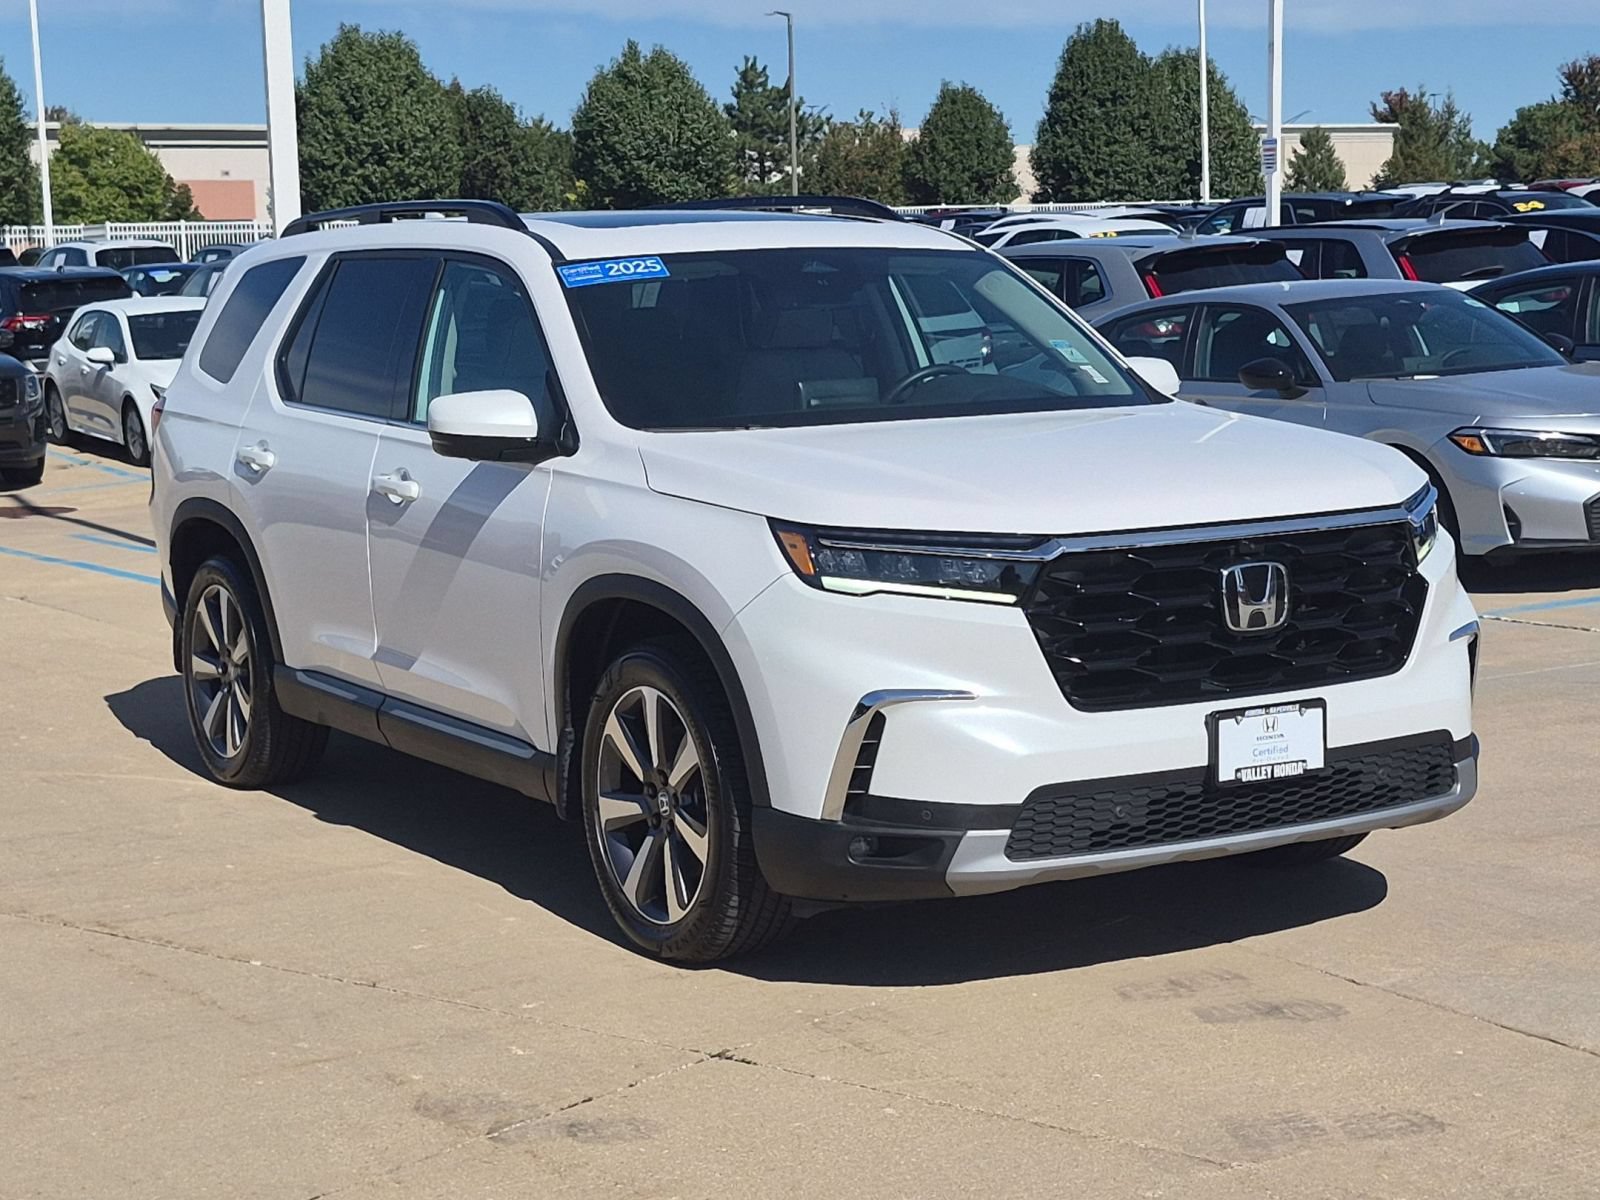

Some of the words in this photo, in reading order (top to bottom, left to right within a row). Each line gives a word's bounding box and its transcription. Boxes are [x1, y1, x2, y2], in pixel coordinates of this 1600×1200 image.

[605, 259, 661, 276] 2025
[1256, 733, 1286, 742] HONDA
[1252, 743, 1289, 757] Certified
[1241, 765, 1273, 782] VALLEY
[1273, 761, 1304, 778] HONDA
